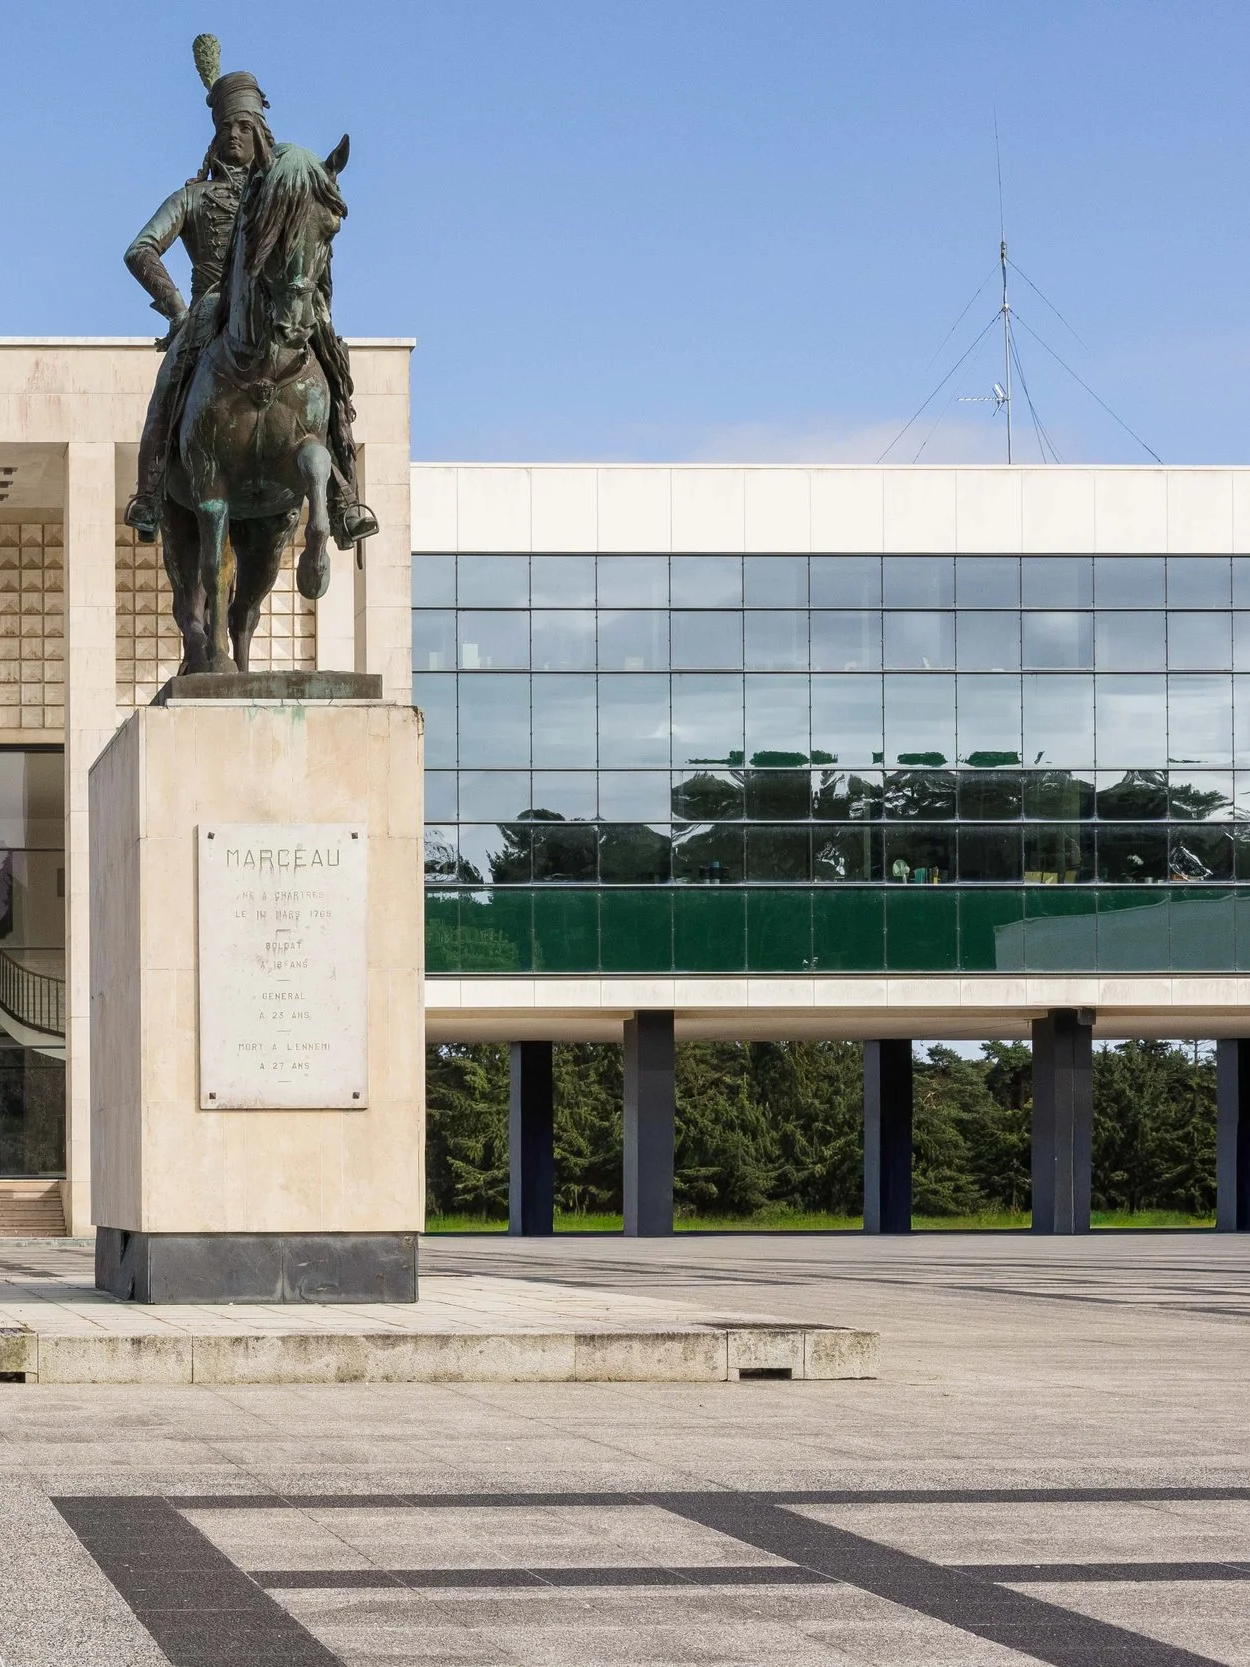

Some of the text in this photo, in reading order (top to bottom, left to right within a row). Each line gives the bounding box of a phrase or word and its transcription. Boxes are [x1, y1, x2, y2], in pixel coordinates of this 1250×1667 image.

[226, 849, 340, 867] MARCEAU
[274, 891, 325, 900] CHARTRES
[235, 910, 247, 918] LE
[275, 910, 301, 919] MARS
[310, 910, 332, 918] 1769
[265, 942, 302, 950] SOLDAT
[272, 1011, 284, 1019] 23
[291, 1011, 310, 1019] ANS
[238, 1043, 263, 1051] MORT
[286, 1043, 331, 1051] LENNEMI
[272, 1062, 284, 1070] 27
[291, 1062, 310, 1070] ANS
